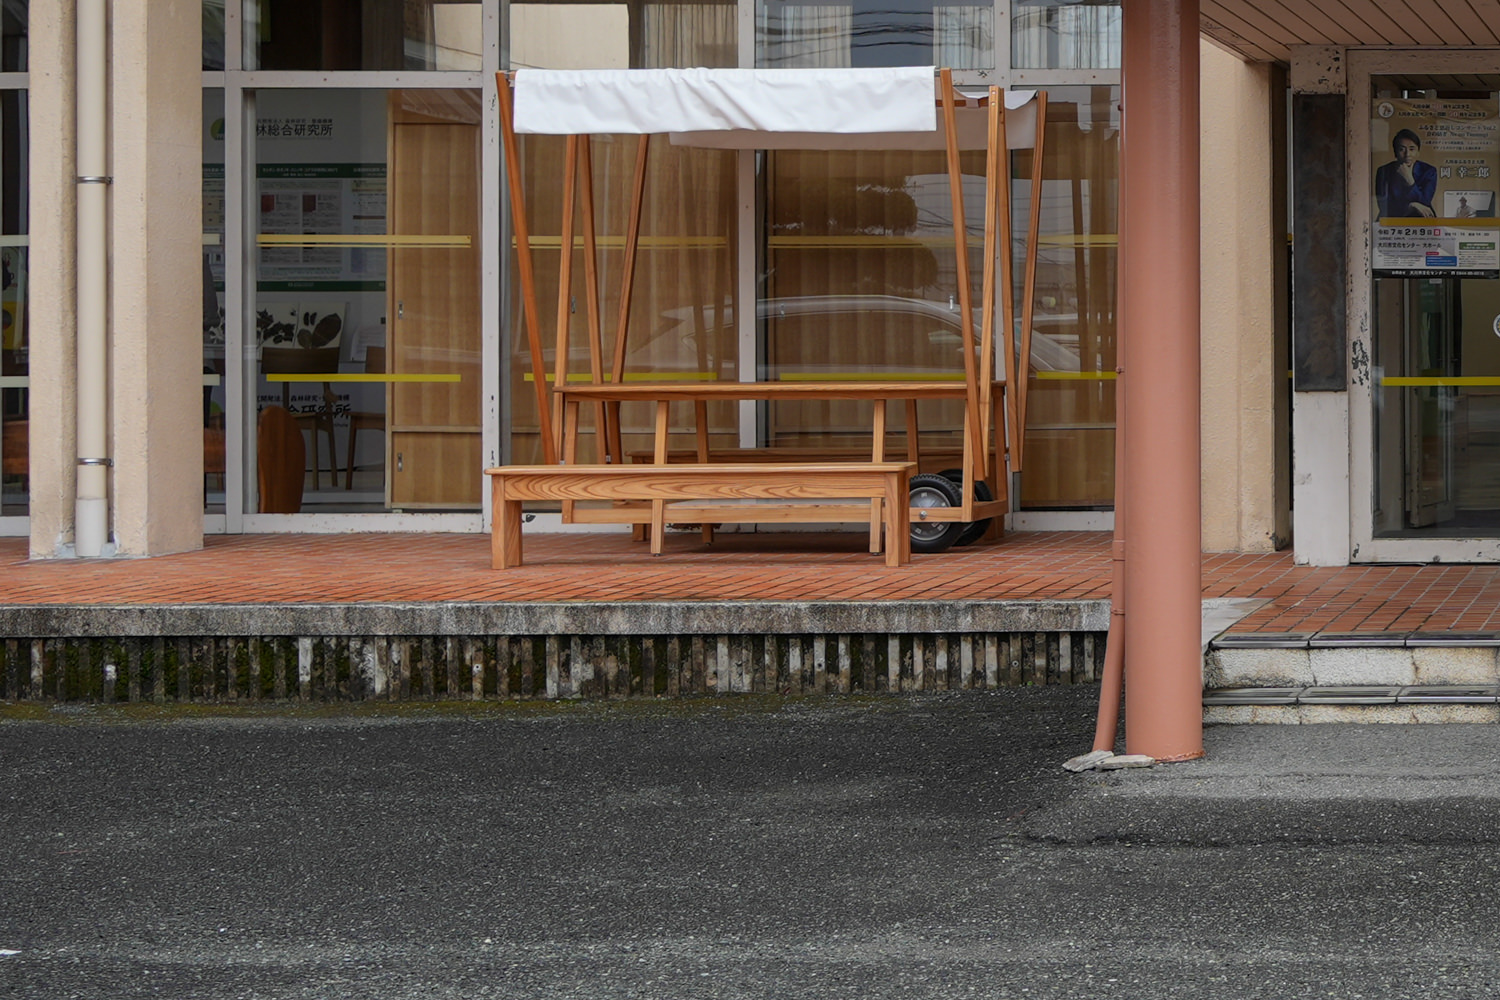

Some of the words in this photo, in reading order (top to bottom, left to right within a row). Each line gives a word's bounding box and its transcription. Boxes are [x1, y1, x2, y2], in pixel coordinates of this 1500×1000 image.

[256, 123, 333, 137] 林総合研究所
